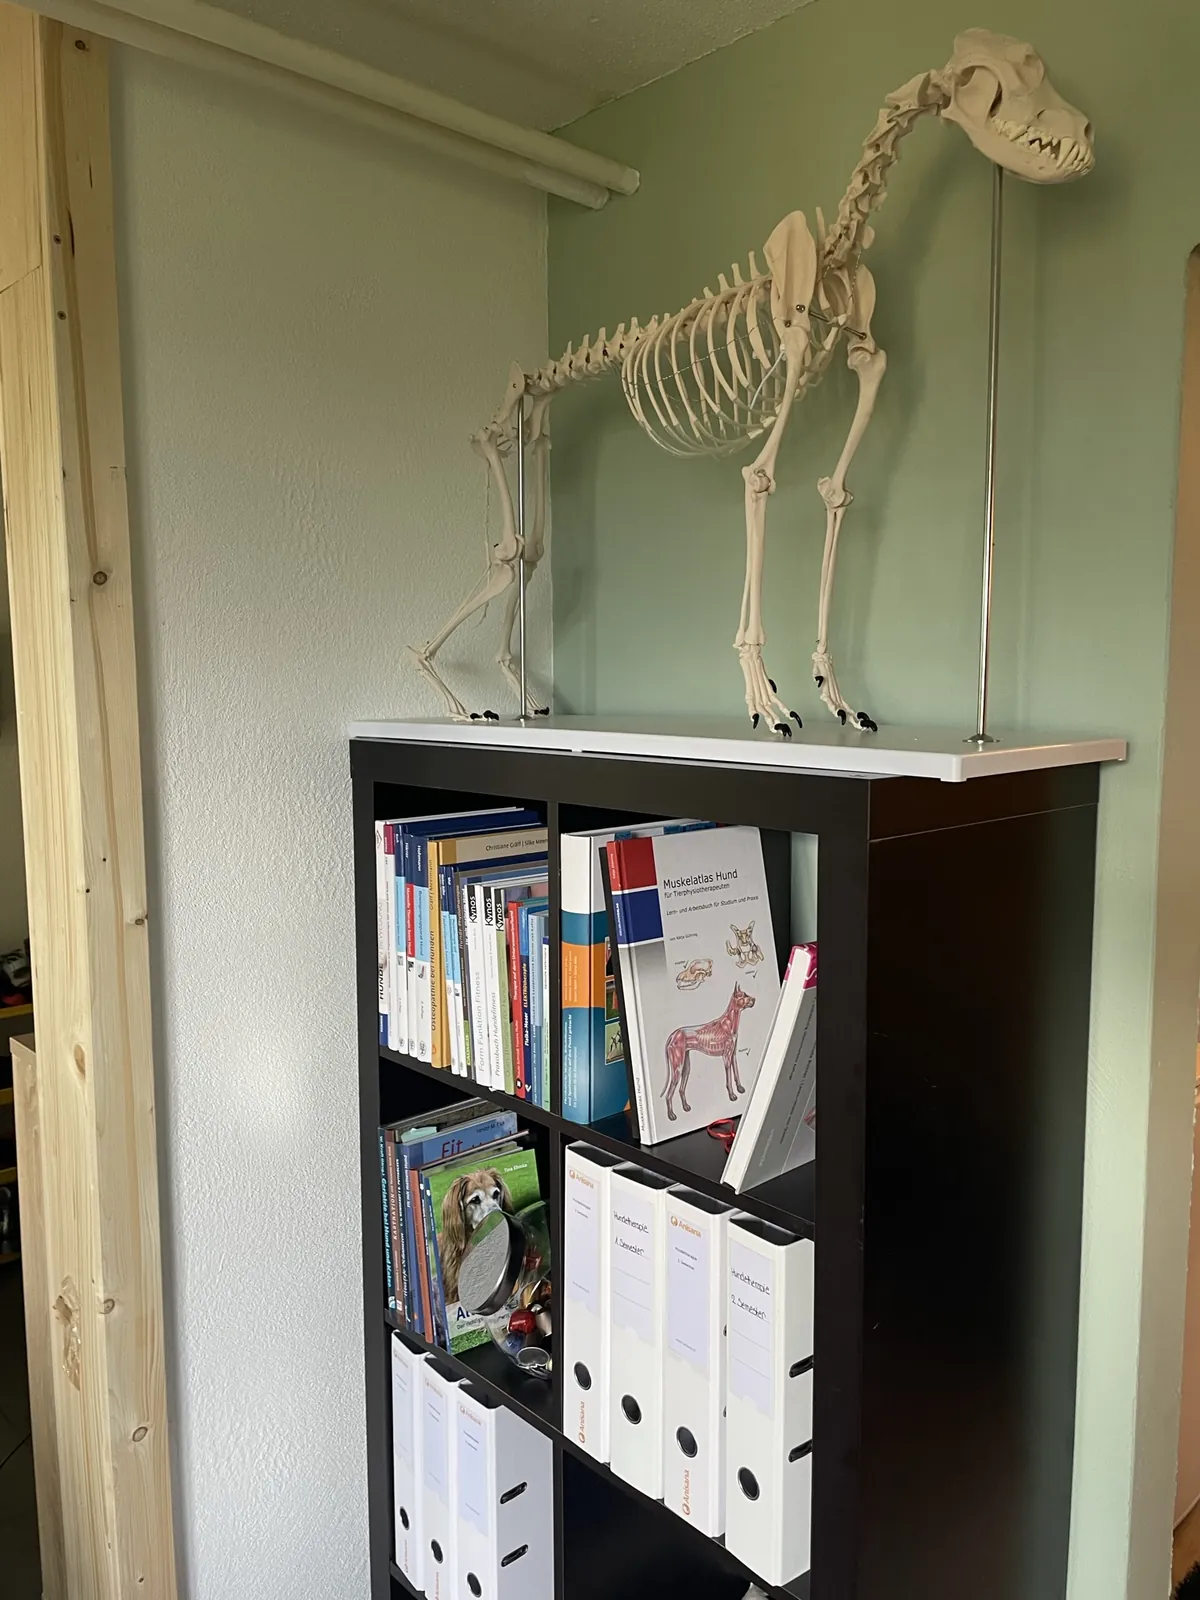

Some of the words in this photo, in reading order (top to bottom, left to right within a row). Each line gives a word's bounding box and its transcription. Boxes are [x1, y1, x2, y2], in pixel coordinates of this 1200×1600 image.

[663, 874, 714, 889] Muskelatlas
[715, 869, 739, 881] Hund
[664, 891, 673, 899] für
[673, 882, 731, 898] Tierphysiotherapeuten
[469, 896, 478, 924] Kynos
[485, 898, 494, 926] Kynos
[688, 902, 713, 912] Arbeitsbuch
[720, 898, 738, 907] Studium
[496, 903, 504, 932] Kynos
[477, 1047, 485, 1072] Form
[441, 1138, 464, 1159] Fit
[381, 1178, 389, 1212] Geriatrie
[390, 1193, 398, 1240] KASTRATION
[613, 1210, 650, 1234] Hundetherapie
[678, 1220, 702, 1238] Anisana
[619, 1238, 645, 1257] Semester
[730, 1266, 771, 1296] Hundetherapie
[737, 1297, 767, 1321] Semester
[681, 1469, 690, 1502] Anisana
